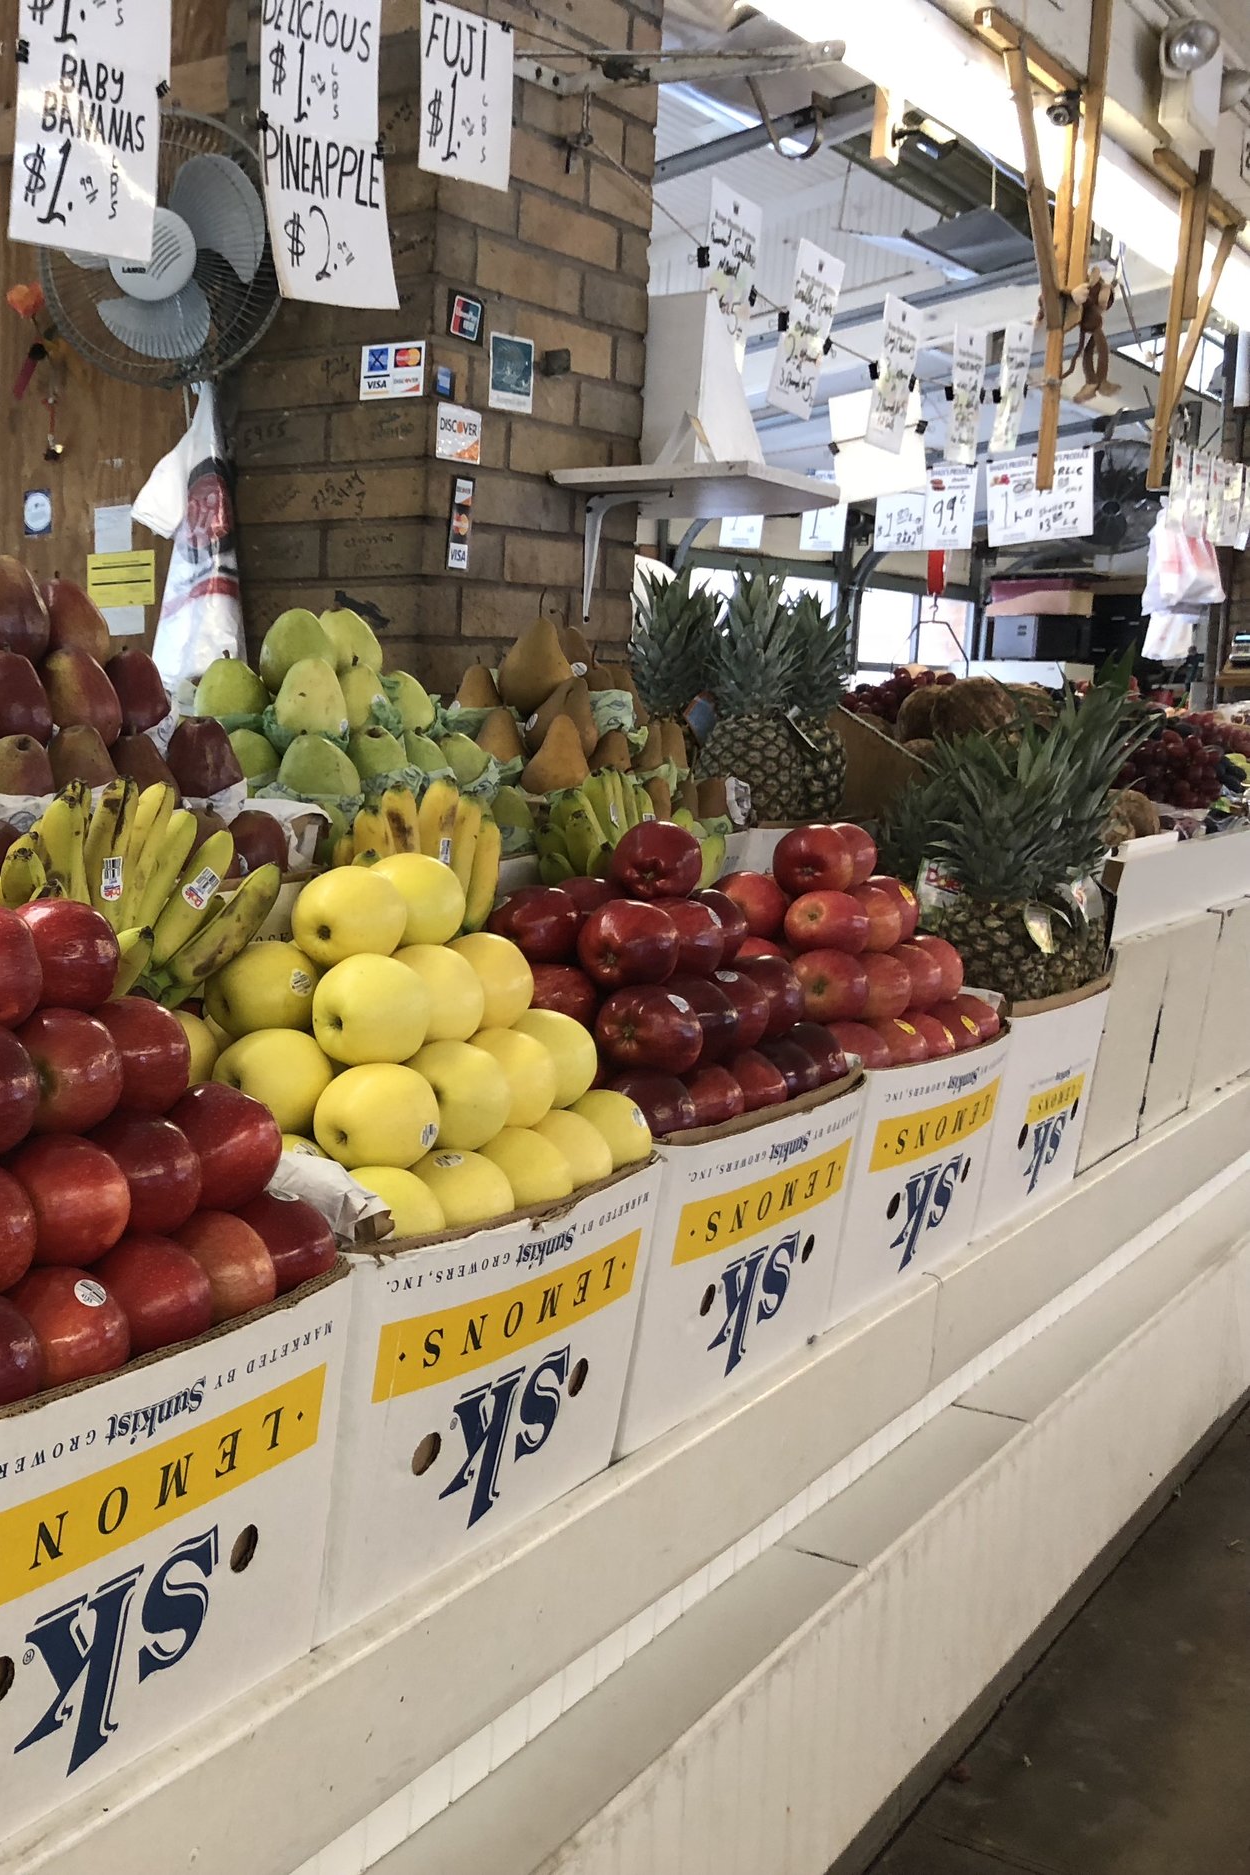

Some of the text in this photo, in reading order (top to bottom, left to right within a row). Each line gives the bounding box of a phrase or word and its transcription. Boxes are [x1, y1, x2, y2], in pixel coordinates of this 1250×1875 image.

[261, 0, 373, 63] DELICIOUS
[59, 53, 125, 104] BABY
[41, 90, 146, 154] BANANAS
[263, 124, 381, 210] PINEAPPLE
[367, 380, 387, 389] VISA
[439, 417, 478, 437] DISCOVER
[450, 548, 466, 563] VISA
[104, 887, 121, 899] Dole
[185, 889, 204, 908] Dole
[948, 1066, 979, 1090] Sunkist
[1037, 1081, 1083, 1112] LEMONS
[813, 1128, 824, 1140] BY
[894, 1092, 992, 1156] LEMONS
[717, 1148, 768, 1175] GROWERS,
[768, 1131, 814, 1166] Sunkist
[688, 1166, 714, 1183] INC.
[704, 1159, 837, 1243] LEMONS
[386, 1190, 650, 1293] MARKETED BY Sunkist GROWERS, INC.
[423, 1256, 618, 1369] LEMONS
[246, 1320, 334, 1374] MARKETED
[214, 1367, 236, 1390] BY
[105, 1377, 207, 1445] Sunkist
